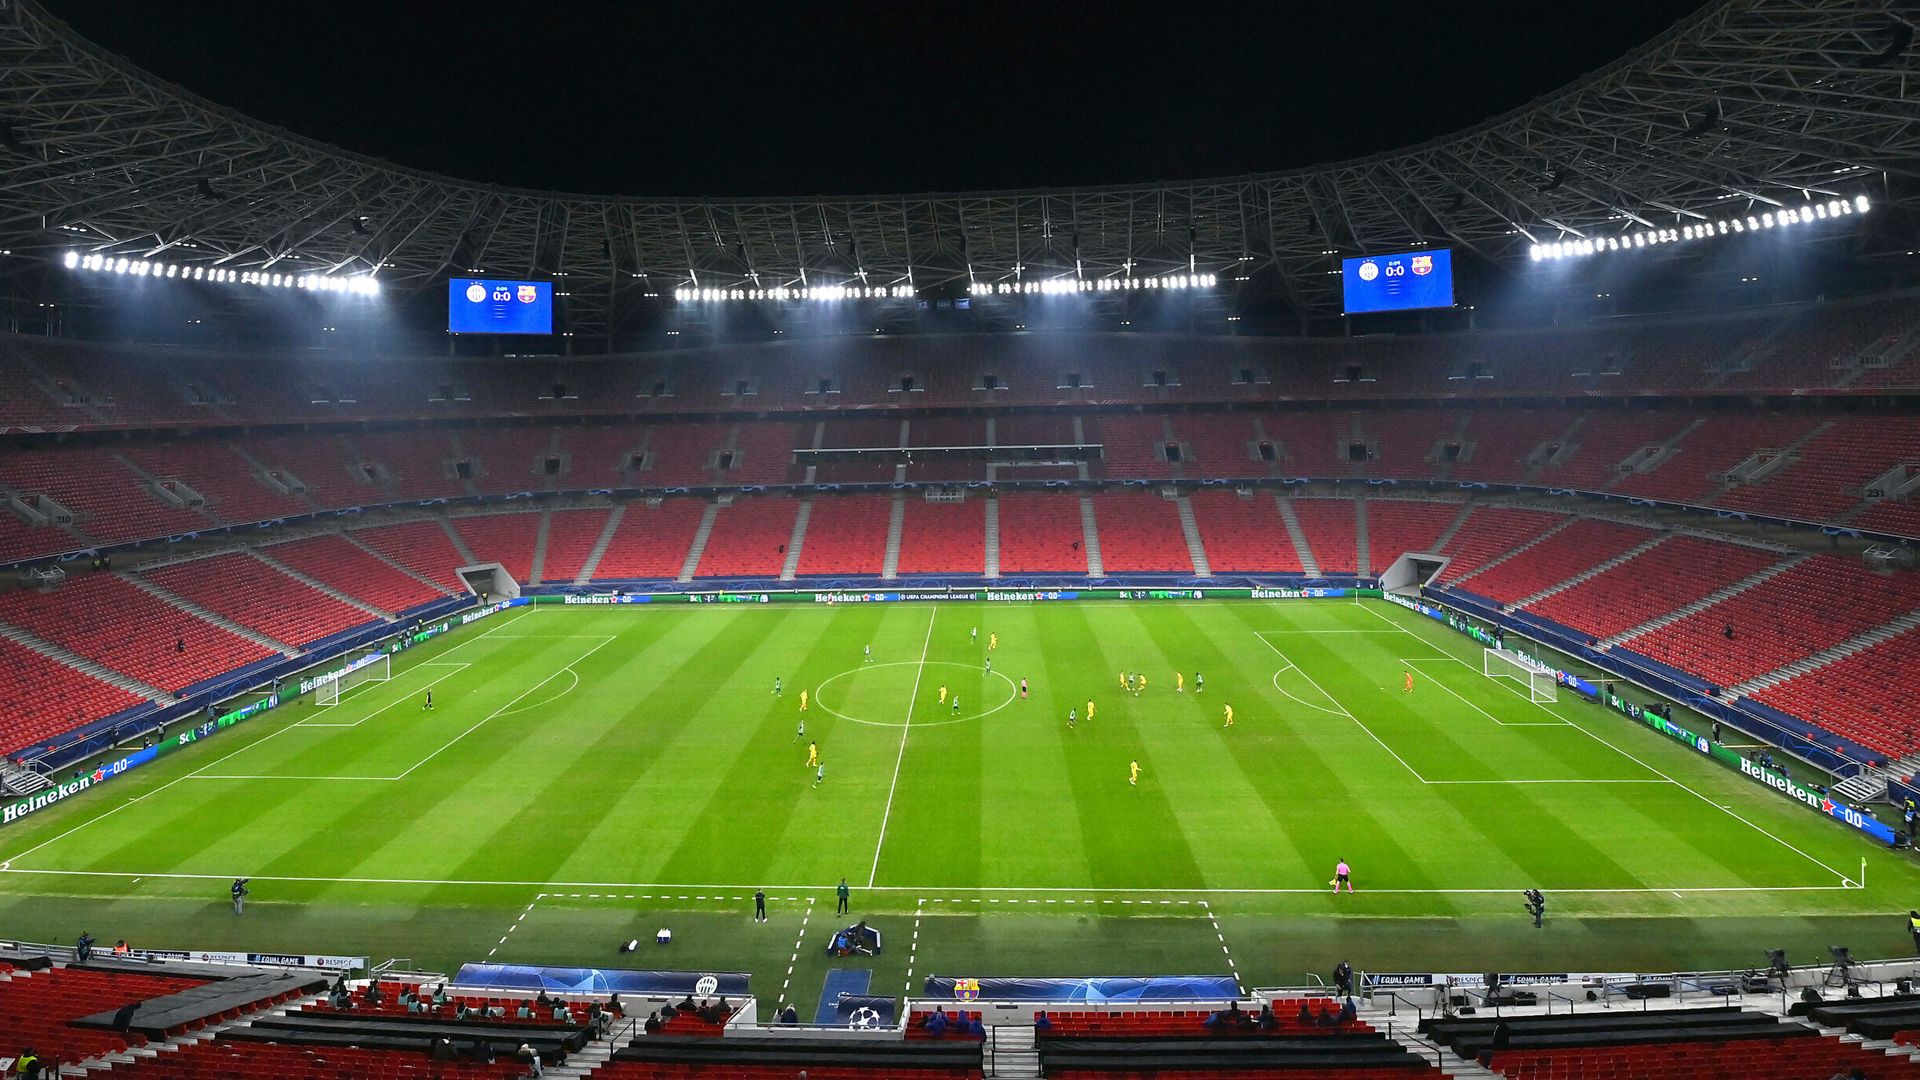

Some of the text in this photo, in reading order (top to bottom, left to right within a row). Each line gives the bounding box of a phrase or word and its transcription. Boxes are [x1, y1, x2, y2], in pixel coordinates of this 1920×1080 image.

[1385, 265, 1405, 277] 0:0
[492, 291, 511, 301] 0:0
[987, 592, 1034, 600] Heineken
[1251, 589, 1300, 598] Heineken
[564, 595, 609, 604] Heineken
[1740, 756, 1819, 808] Heineken
[2, 776, 90, 824] Heineken
[1405, 976, 1425, 984] GAME
